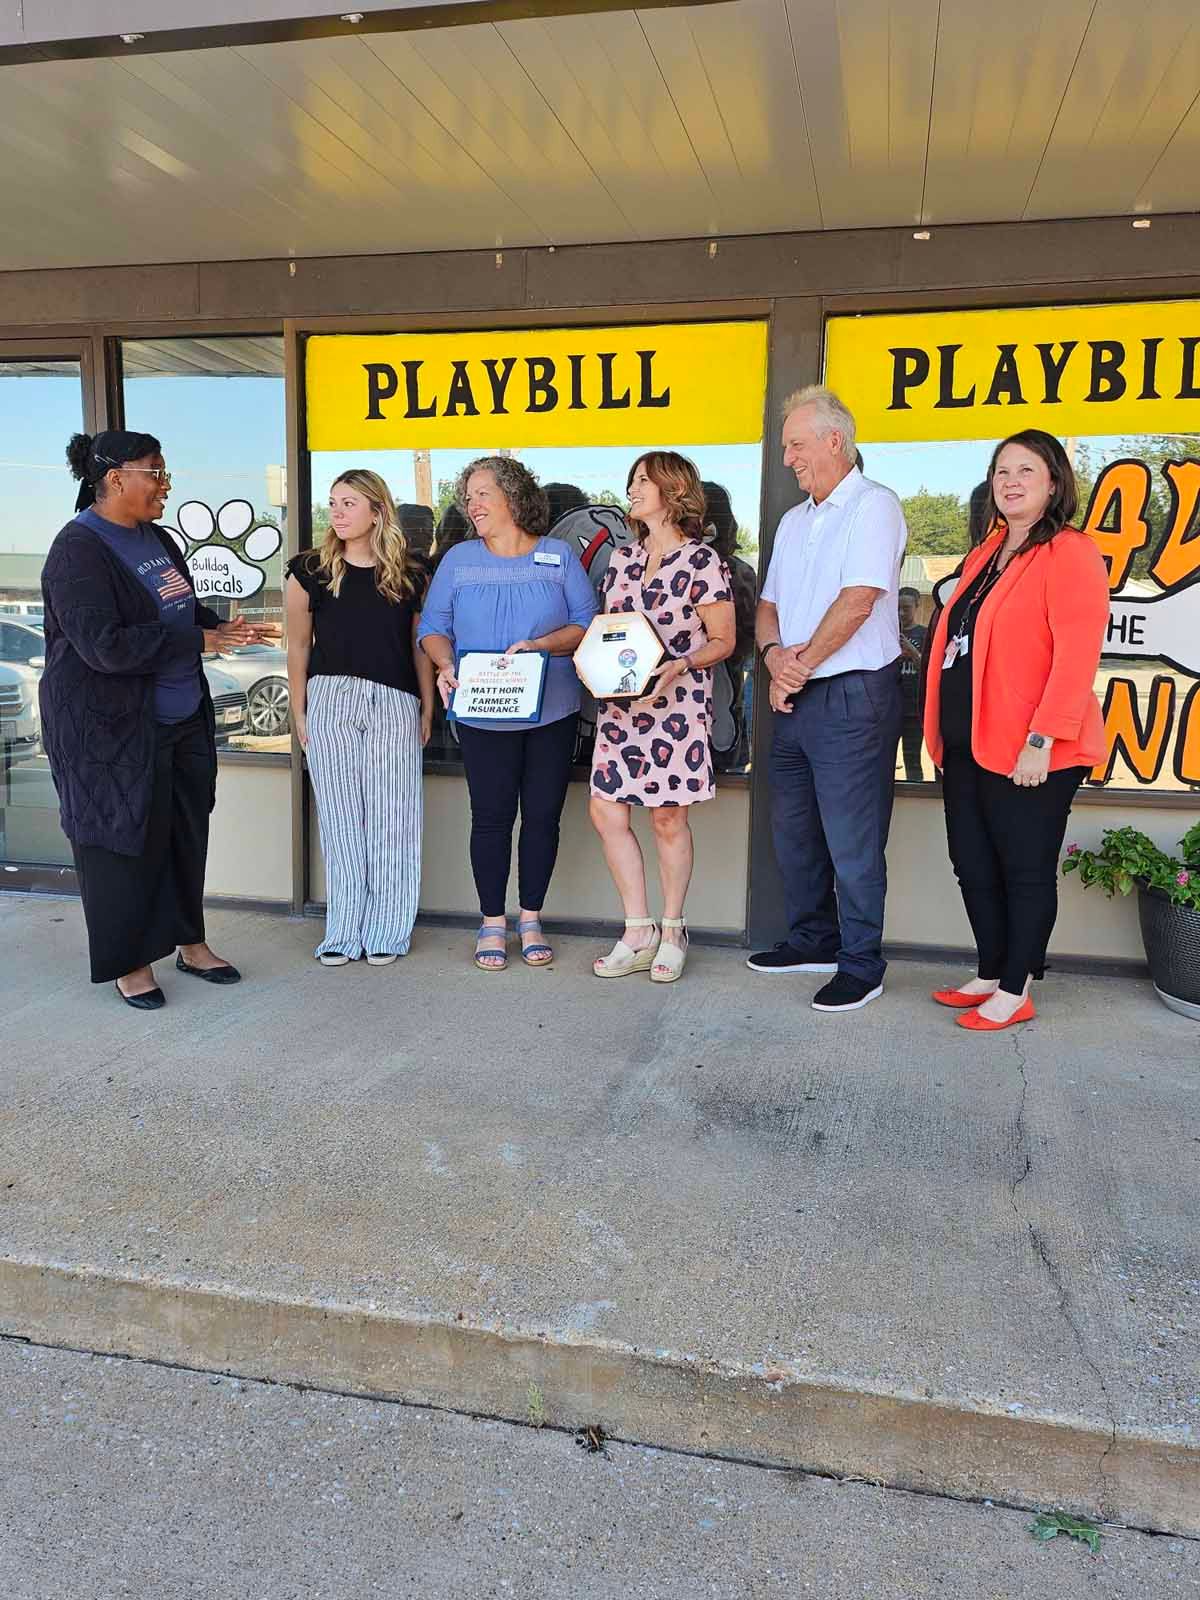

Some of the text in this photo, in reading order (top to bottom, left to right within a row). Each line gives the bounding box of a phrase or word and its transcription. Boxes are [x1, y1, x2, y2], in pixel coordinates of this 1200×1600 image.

[362, 351, 671, 420] PLAYBILL
[137, 556, 171, 575] OLD NAVY
[192, 556, 229, 576] Bulldog
[191, 575, 243, 593] usicals
[1106, 613, 1146, 645] HE
[472, 697, 519, 705] FARMER'S
